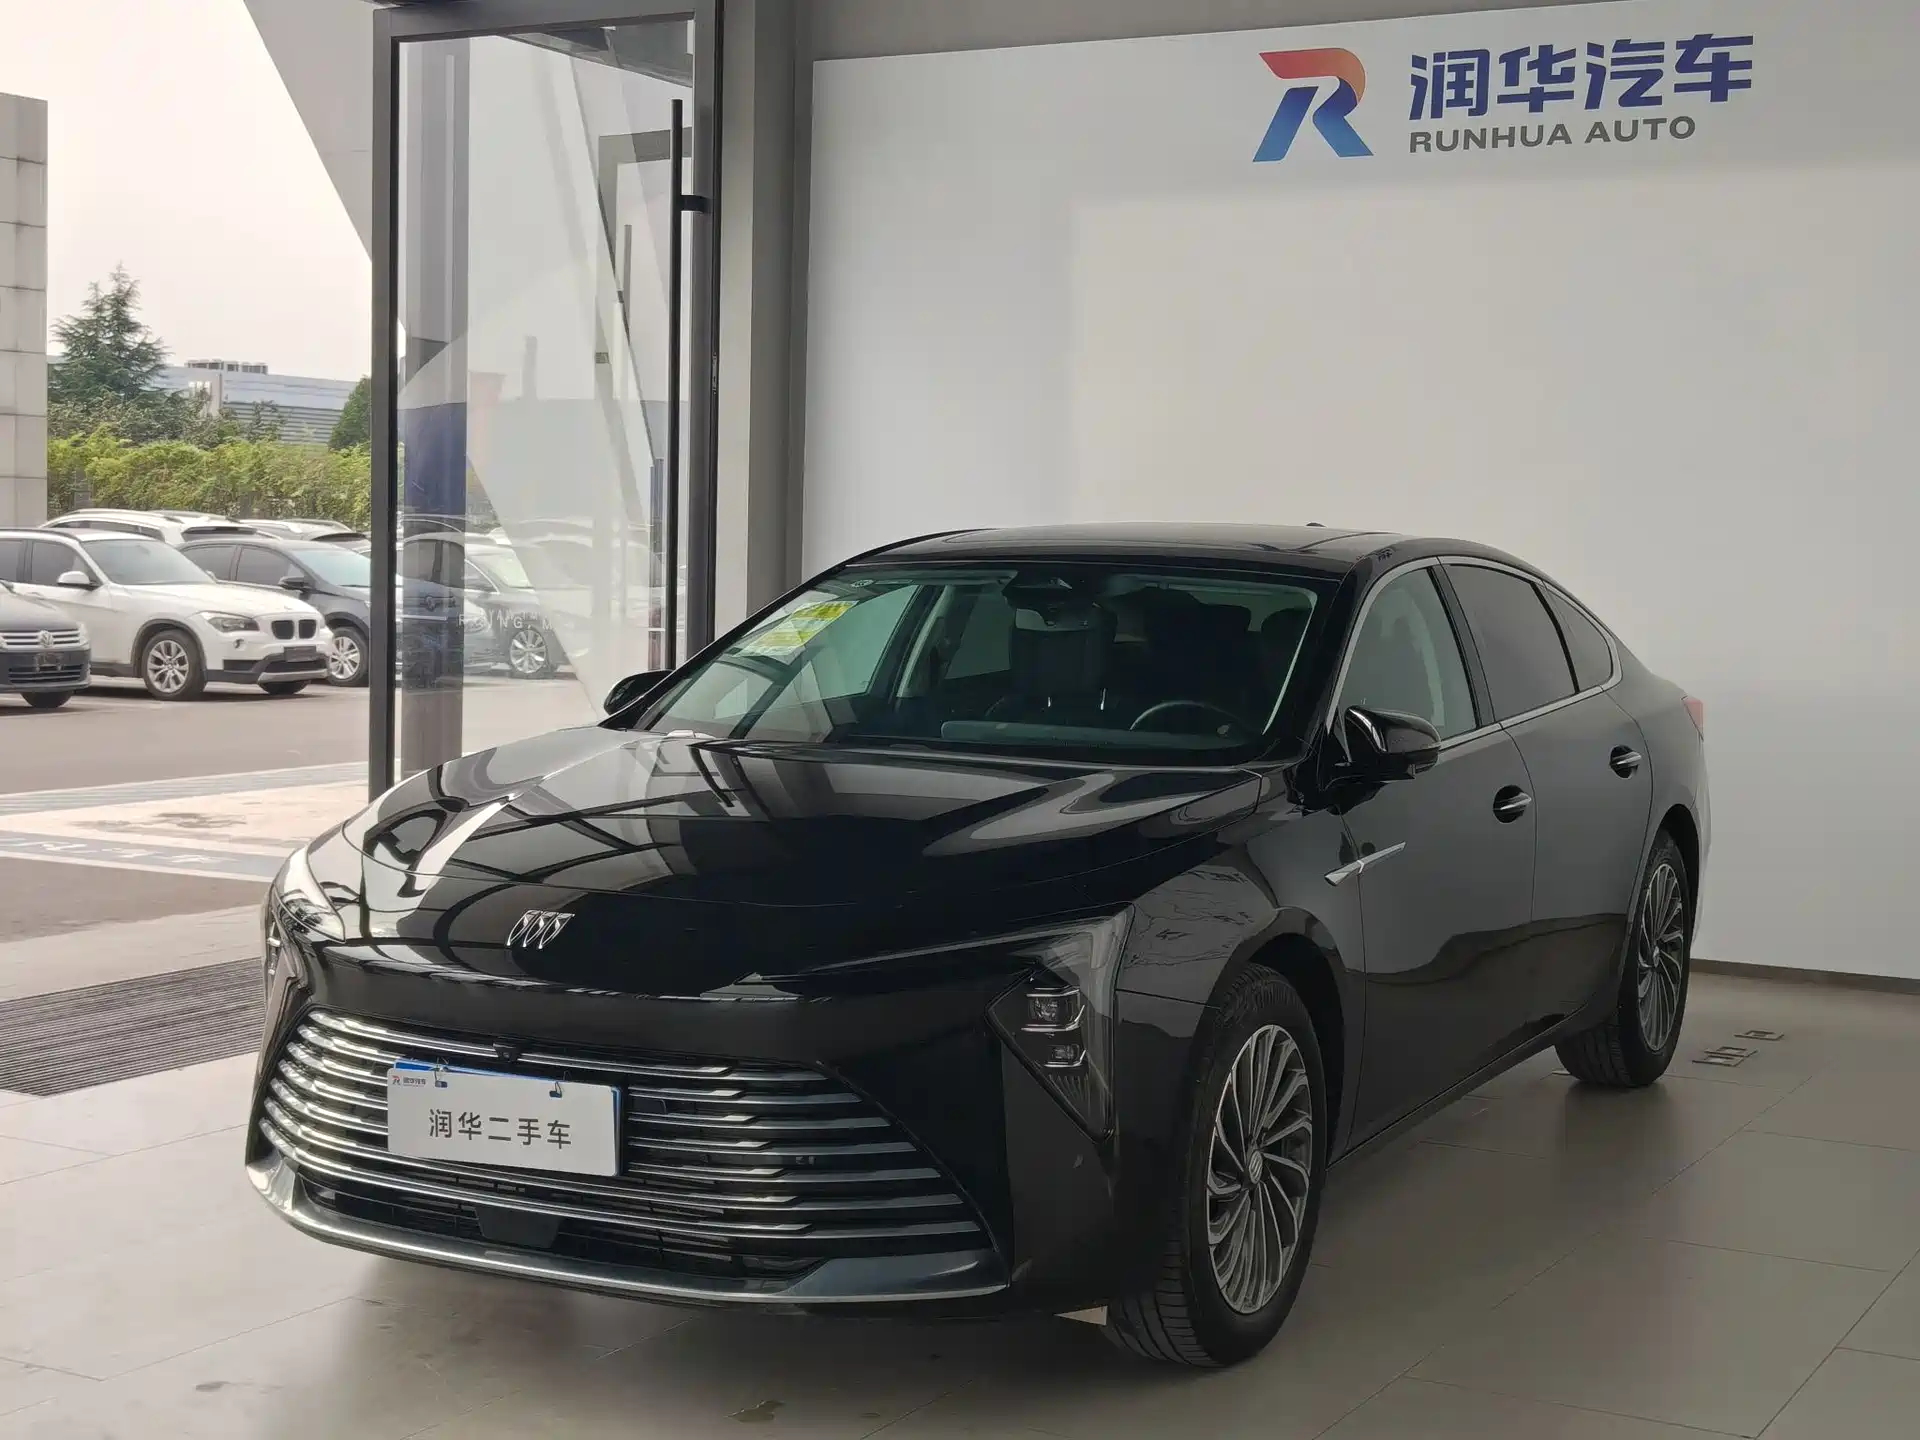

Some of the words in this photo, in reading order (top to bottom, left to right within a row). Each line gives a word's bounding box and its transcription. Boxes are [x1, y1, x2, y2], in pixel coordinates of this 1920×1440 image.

[1409, 34, 1754, 120] 润华汽车
[1409, 123, 1573, 153] RUNHUA
[1585, 115, 1696, 145] AUTO
[429, 1108, 571, 1150] 润华二手车
